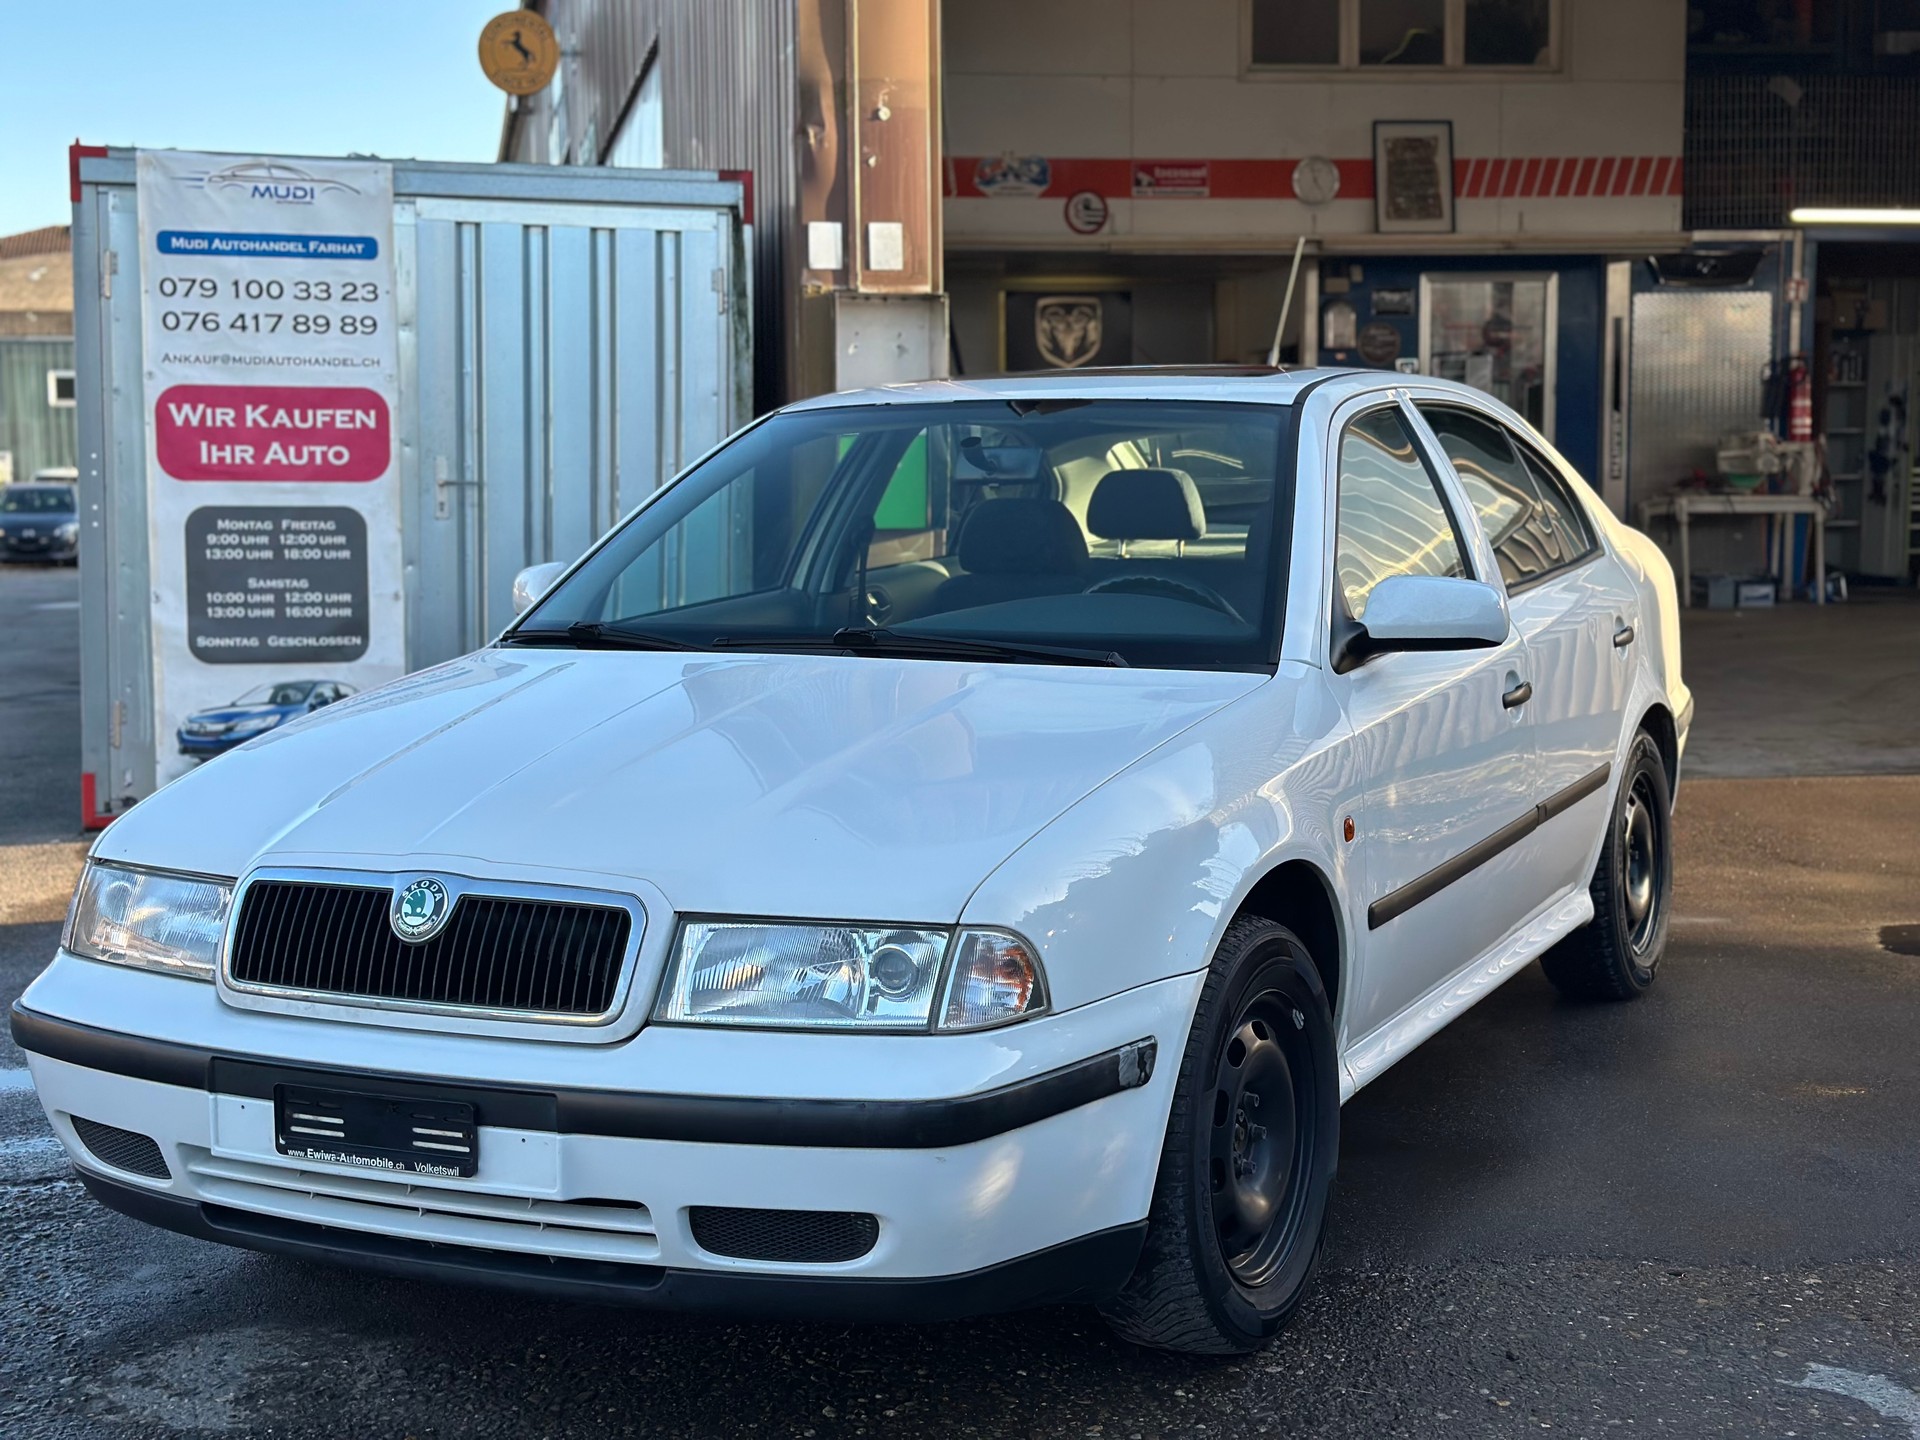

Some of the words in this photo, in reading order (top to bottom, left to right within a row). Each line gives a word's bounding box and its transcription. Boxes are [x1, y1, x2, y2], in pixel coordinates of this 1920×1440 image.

[251, 185, 314, 200] MUDI
[171, 236, 208, 250] MUDI
[211, 238, 306, 254] AUTOHANDEL
[308, 240, 365, 254] FARHAT
[158, 277, 218, 299] 079
[231, 279, 284, 301] 100
[293, 281, 332, 302] 33
[341, 283, 379, 302] 23
[161, 311, 220, 332] 076
[229, 313, 283, 334] 417
[292, 314, 331, 335] 89
[340, 315, 378, 335] 89
[167, 403, 235, 428] WIR
[245, 404, 376, 429] KAUFEN
[200, 440, 255, 465] IHR
[263, 442, 350, 466] AUTO
[217, 519, 273, 531] MONTAG
[281, 519, 336, 531] FREITAG
[206, 534, 240, 545] 9:00
[241, 535, 270, 545] UHR
[279, 534, 317, 545] 12:00
[319, 535, 347, 545] UHR
[205, 549, 244, 560] 13:00
[245, 549, 274, 560] UHR
[323, 550, 351, 560] UHR
[247, 577, 310, 589] SAMSTAG
[206, 592, 245, 604] 10:00
[246, 593, 275, 603] UHR
[285, 592, 323, 603] 12:00
[324, 593, 352, 603] UHR
[206, 607, 246, 618] 13:00
[247, 607, 275, 618] UHR
[325, 608, 352, 618] UHR
[196, 636, 260, 648] SONNTAG
[267, 635, 362, 648] GESCHLOSSEN
[414, 1162, 459, 1177] Volketswil
